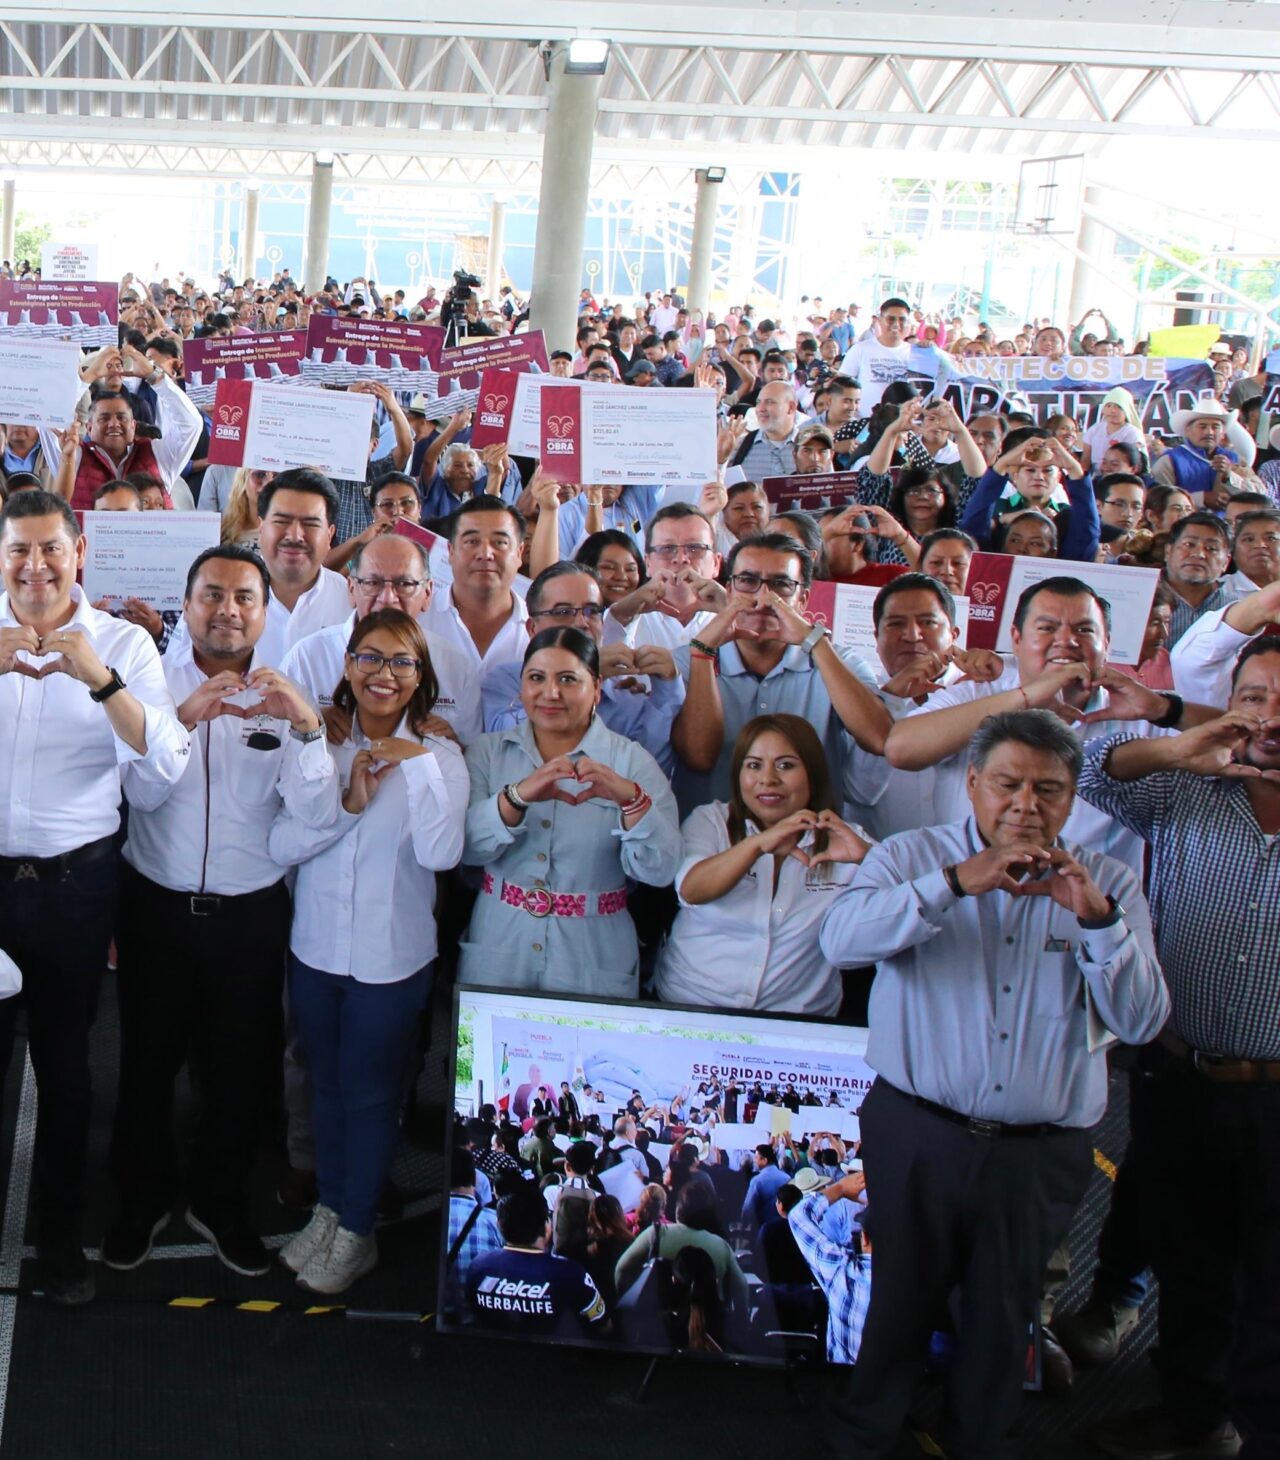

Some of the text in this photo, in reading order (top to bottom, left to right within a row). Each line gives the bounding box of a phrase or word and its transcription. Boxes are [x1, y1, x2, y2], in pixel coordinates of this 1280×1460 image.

[345, 332, 370, 341] Entrega
[326, 337, 364, 346] Estratégicos
[389, 343, 424, 352] Producción
[202, 356, 241, 364] Estratégicos
[453, 357, 477, 368] Entrega
[487, 351, 512, 360] Insumos
[475, 362, 489, 370] para
[497, 354, 530, 364] Producción
[1120, 357, 1166, 380] DE
[480, 416, 504, 425] OBRA
[216, 429, 240, 437] OBRA
[547, 442, 574, 451] OBRA
[969, 609, 995, 618] OBRA
[693, 1064, 873, 1089] SEGURIDAD COMUNITARIA
[495, 1278, 550, 1299] telcel
[477, 1294, 553, 1314] HERBALIFE
